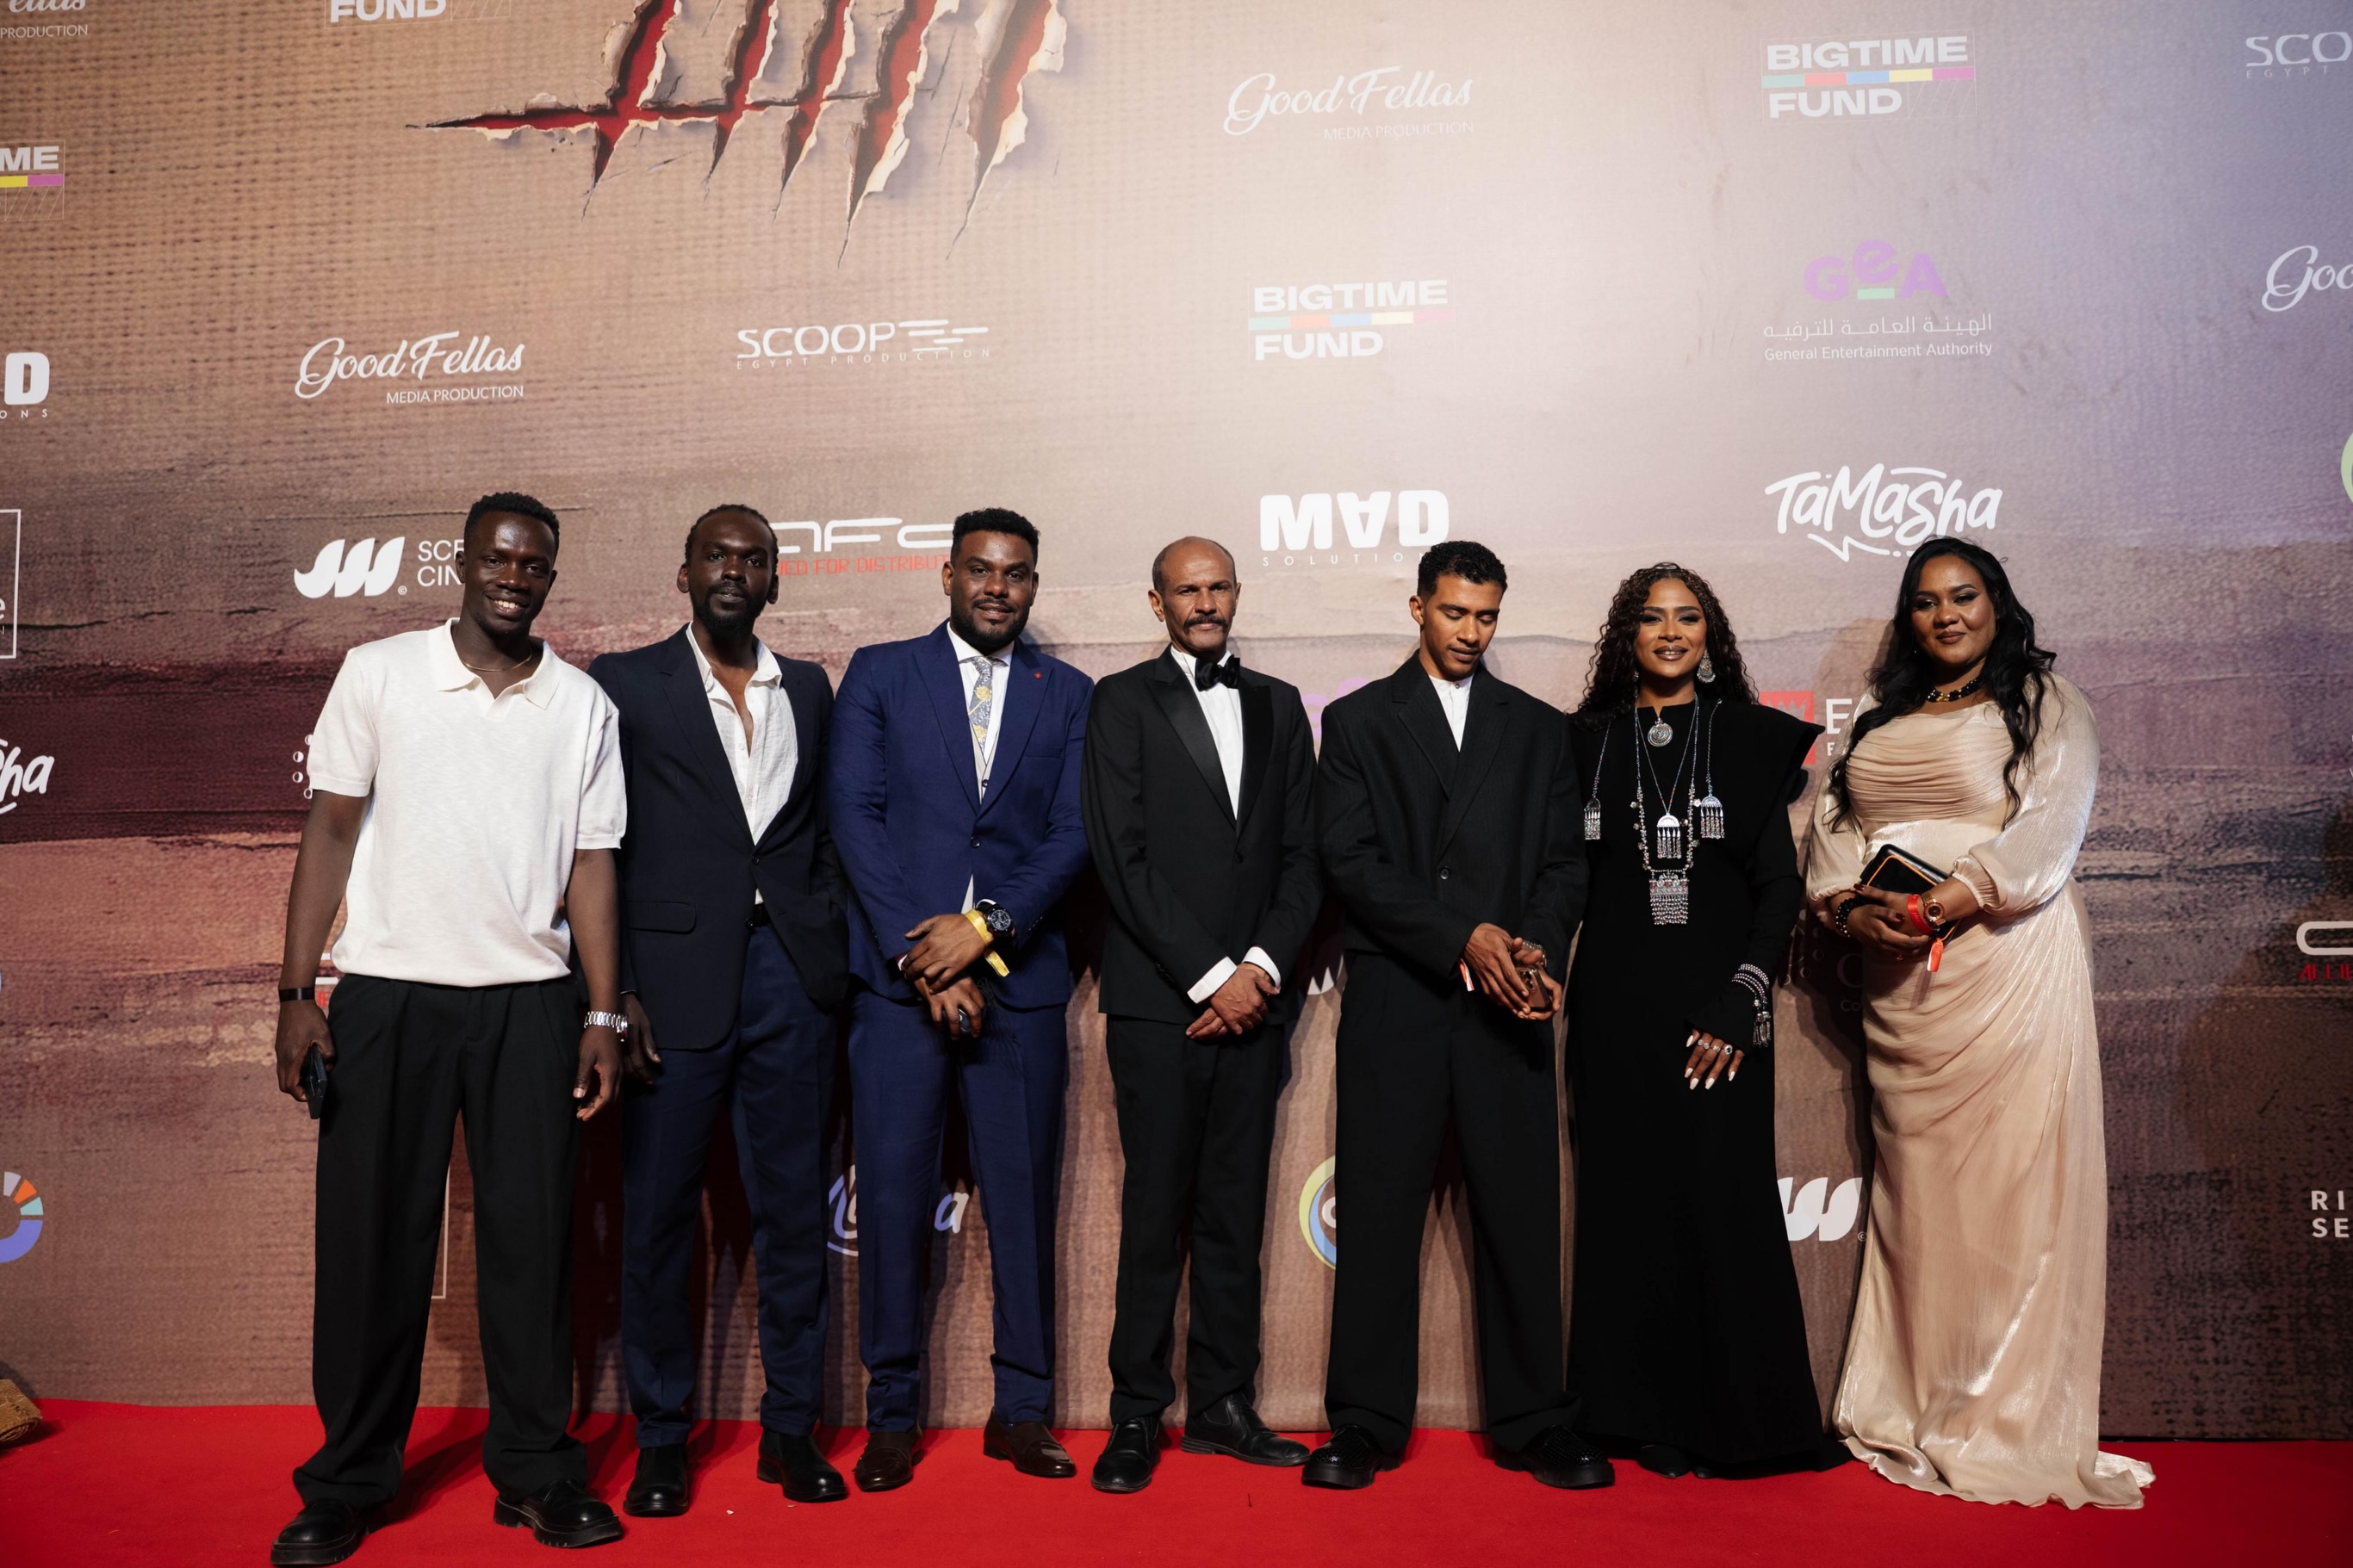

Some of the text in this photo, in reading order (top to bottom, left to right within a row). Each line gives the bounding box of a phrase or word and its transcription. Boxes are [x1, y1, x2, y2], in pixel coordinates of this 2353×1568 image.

[331, 0, 447, 23] FUND
[0, 24, 88, 39] PRODUCTION
[1767, 36, 1969, 70] BIGTIME
[2246, 65, 2329, 79] EGYPT
[1223, 65, 1474, 135] Good Fellas
[1769, 89, 1903, 119] FUND
[1324, 121, 1474, 140] MEDIA PRODUCTION
[1254, 280, 1448, 313] BIGTIME
[1764, 313, 1992, 341] الهيئة العامة للترفيه
[737, 322, 896, 359] SCOOP
[1255, 331, 1384, 361] FUND
[1765, 342, 1993, 362] General Entertainment Authority
[295, 331, 525, 399] Good Fellas
[736, 349, 990, 370] EGYPT PRODUCTION
[387, 385, 524, 404] MEDIA PRODUCTION
[814, 559, 850, 575] FOR
[1262, 552, 1426, 567] SOLUTIO
